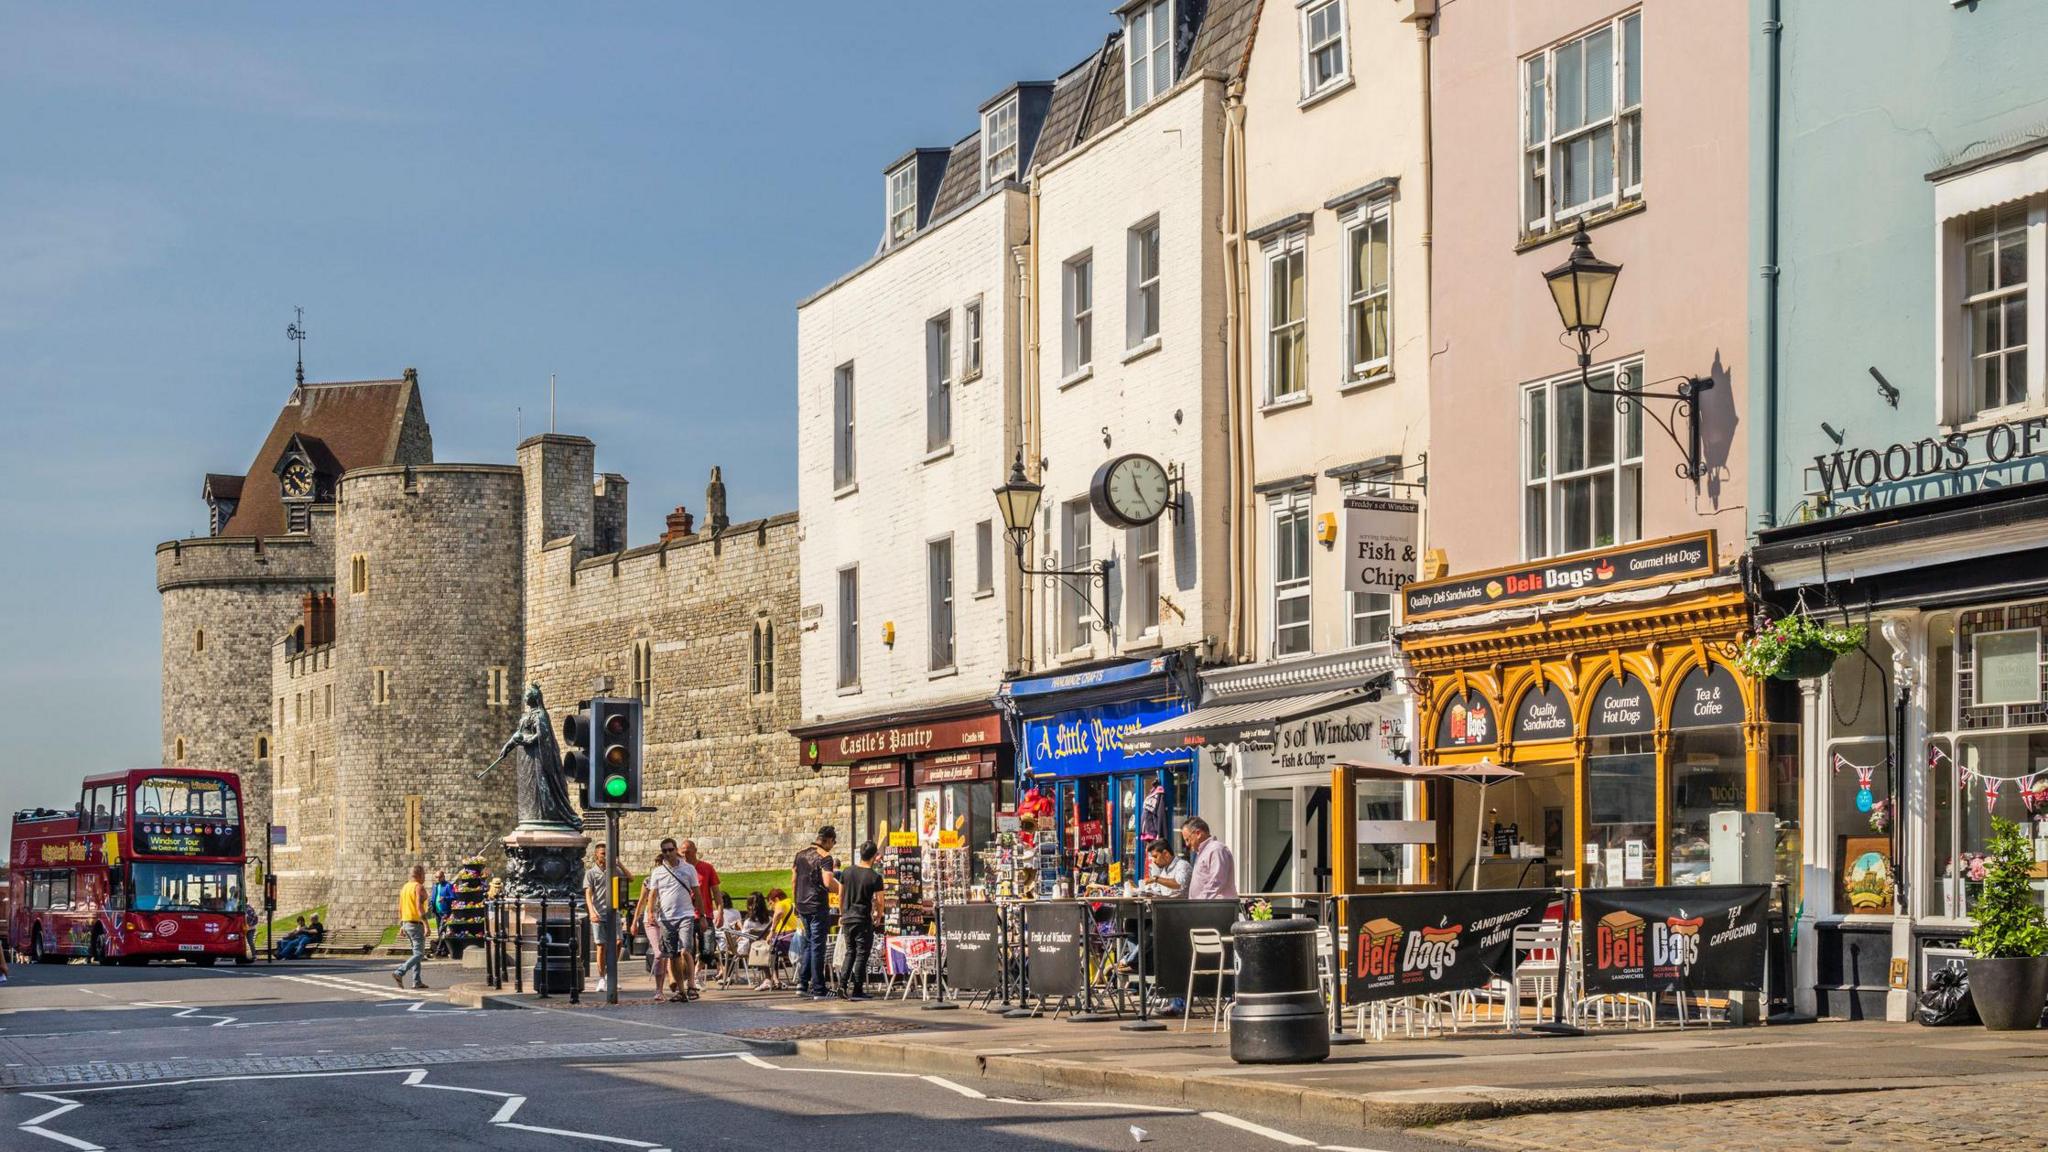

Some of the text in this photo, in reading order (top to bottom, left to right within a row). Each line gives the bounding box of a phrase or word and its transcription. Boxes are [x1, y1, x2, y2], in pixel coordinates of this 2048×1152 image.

[1814, 418, 2048, 495] WOODS OF
[1388, 503, 1416, 512] Windsor
[1358, 541, 1416, 562] Fish &
[1361, 567, 1415, 591] Chips
[1410, 550, 1701, 609] Quality Deli Sandwiches Deli Dogs Gourmet Hot Dogs
[1604, 695, 1639, 709] Gourmet
[1696, 687, 1721, 701] Tea &
[1529, 702, 1557, 718] Quality
[1603, 710, 1640, 725] Hot Dogs
[1694, 701, 1722, 716] Coffee
[1294, 716, 1373, 748] of Windsor
[1467, 711, 1486, 743] Dogs
[1523, 715, 1566, 731] Sandwiches
[840, 728, 933, 755] Castle's Pantry
[965, 732, 977, 744] Castle
[1037, 725, 1052, 760] A
[1055, 719, 1089, 759] Little
[1281, 750, 1326, 769] Fish & Chips
[151, 836, 200, 846] Windsor Tour
[1470, 906, 1532, 933] SANDWICHES
[1728, 905, 1742, 918] TEA
[1728, 918, 1735, 928] &
[1480, 929, 1511, 949] PANINI
[1710, 922, 1757, 947] CAPPUCCINO
[1357, 930, 1459, 980] Deli Dogs
[1597, 922, 1700, 977] Deli Dogs
